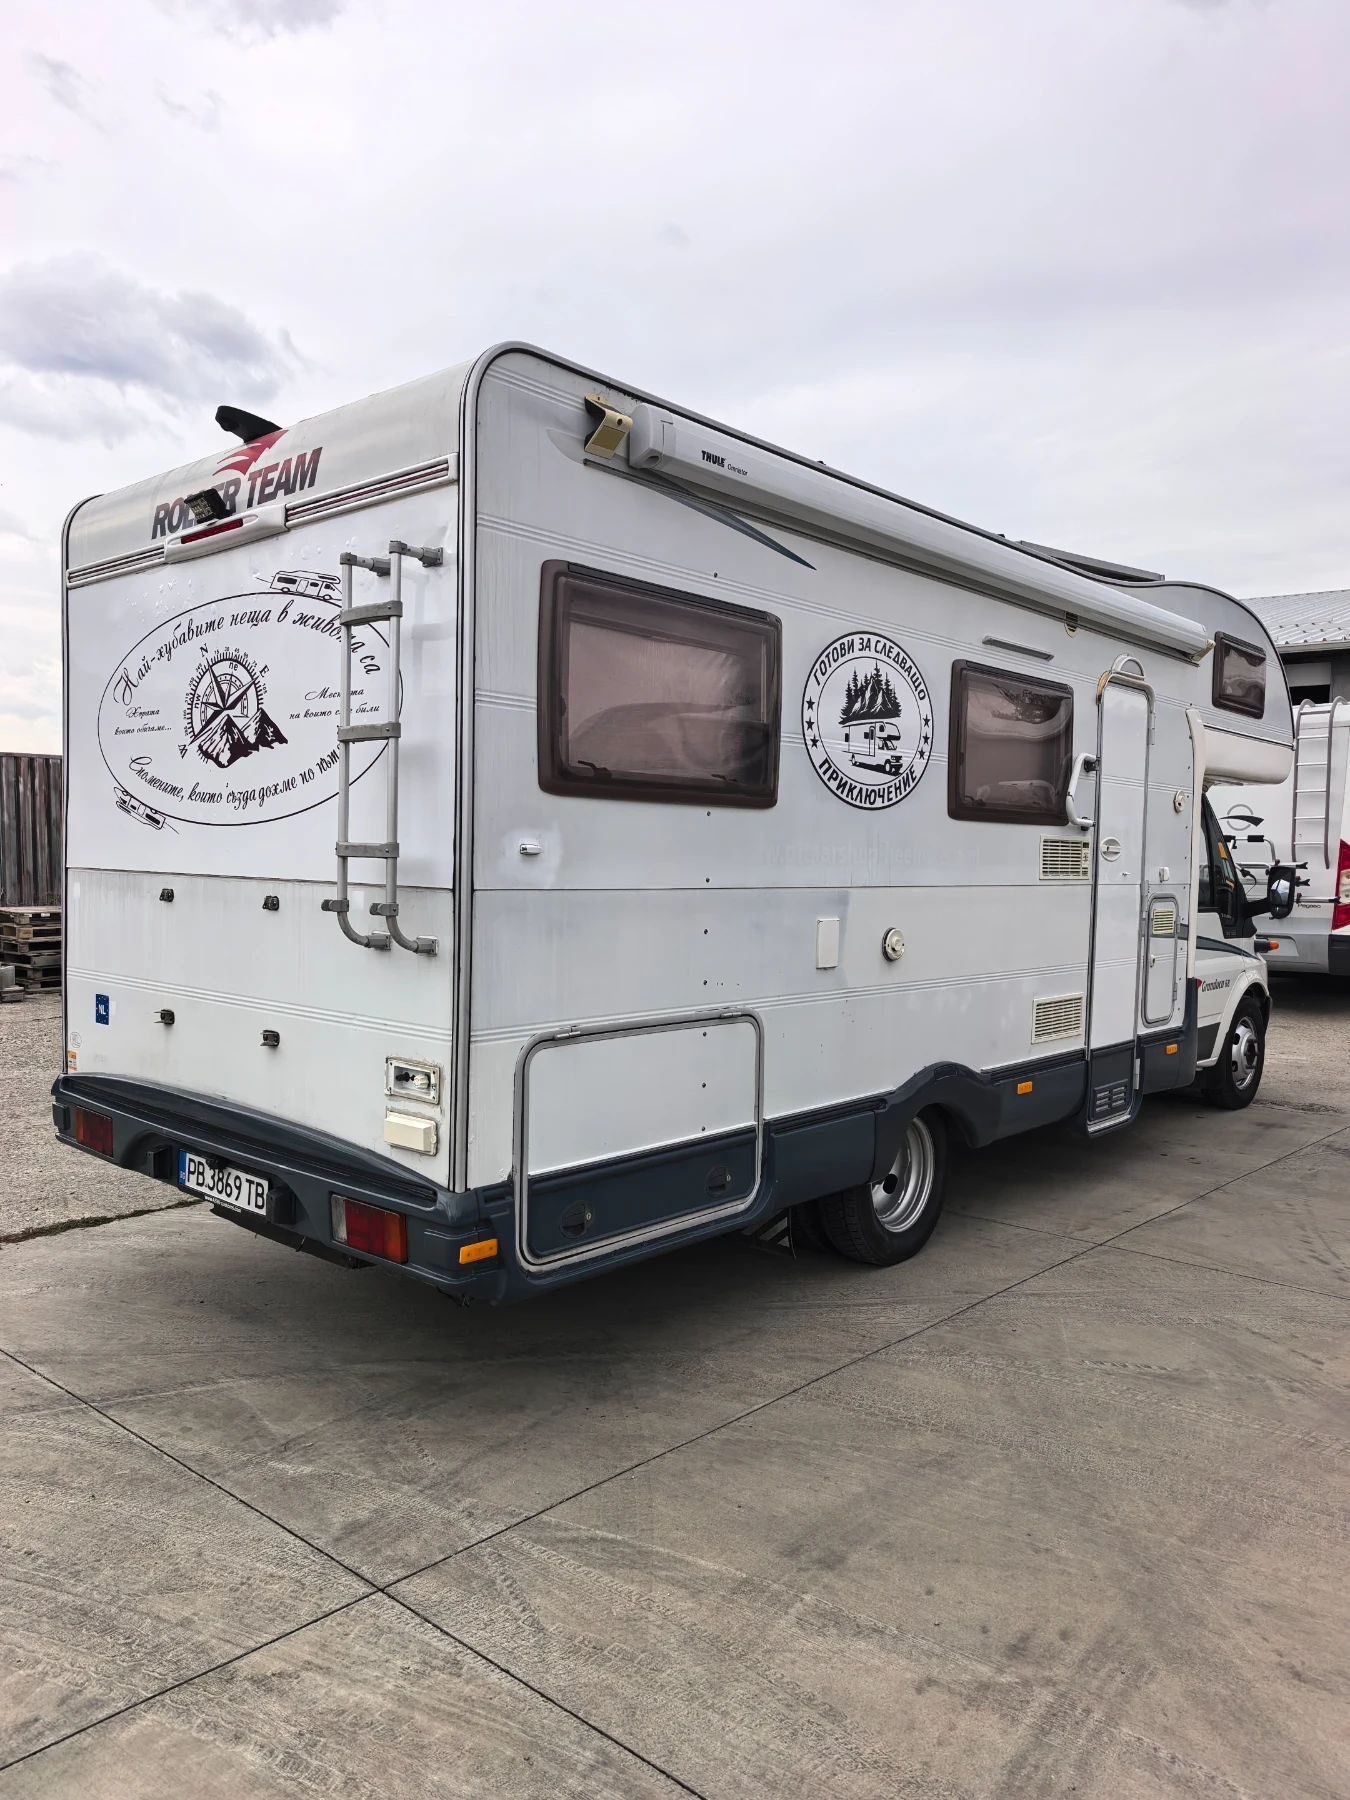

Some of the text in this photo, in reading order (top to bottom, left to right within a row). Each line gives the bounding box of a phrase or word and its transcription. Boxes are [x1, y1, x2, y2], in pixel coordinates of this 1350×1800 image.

[701, 450, 725, 468] THULE
[151, 446, 323, 541] ROLR TEAM
[113, 599, 380, 706] Най-хубавите неща в живоа са
[813, 637, 927, 701] ГОТОВИ ЗА СЛЕДВАЩО
[187, 782, 223, 804] които
[299, 767, 315, 785] по
[315, 743, 340, 774] път
[818, 756, 918, 806] ПРИКЛЮЧЕНИЕ
[98, 1003, 107, 1015] NL
[187, 1157, 206, 1188] PB
[207, 1168, 242, 1202] 3869
[245, 1177, 266, 1210] TB
